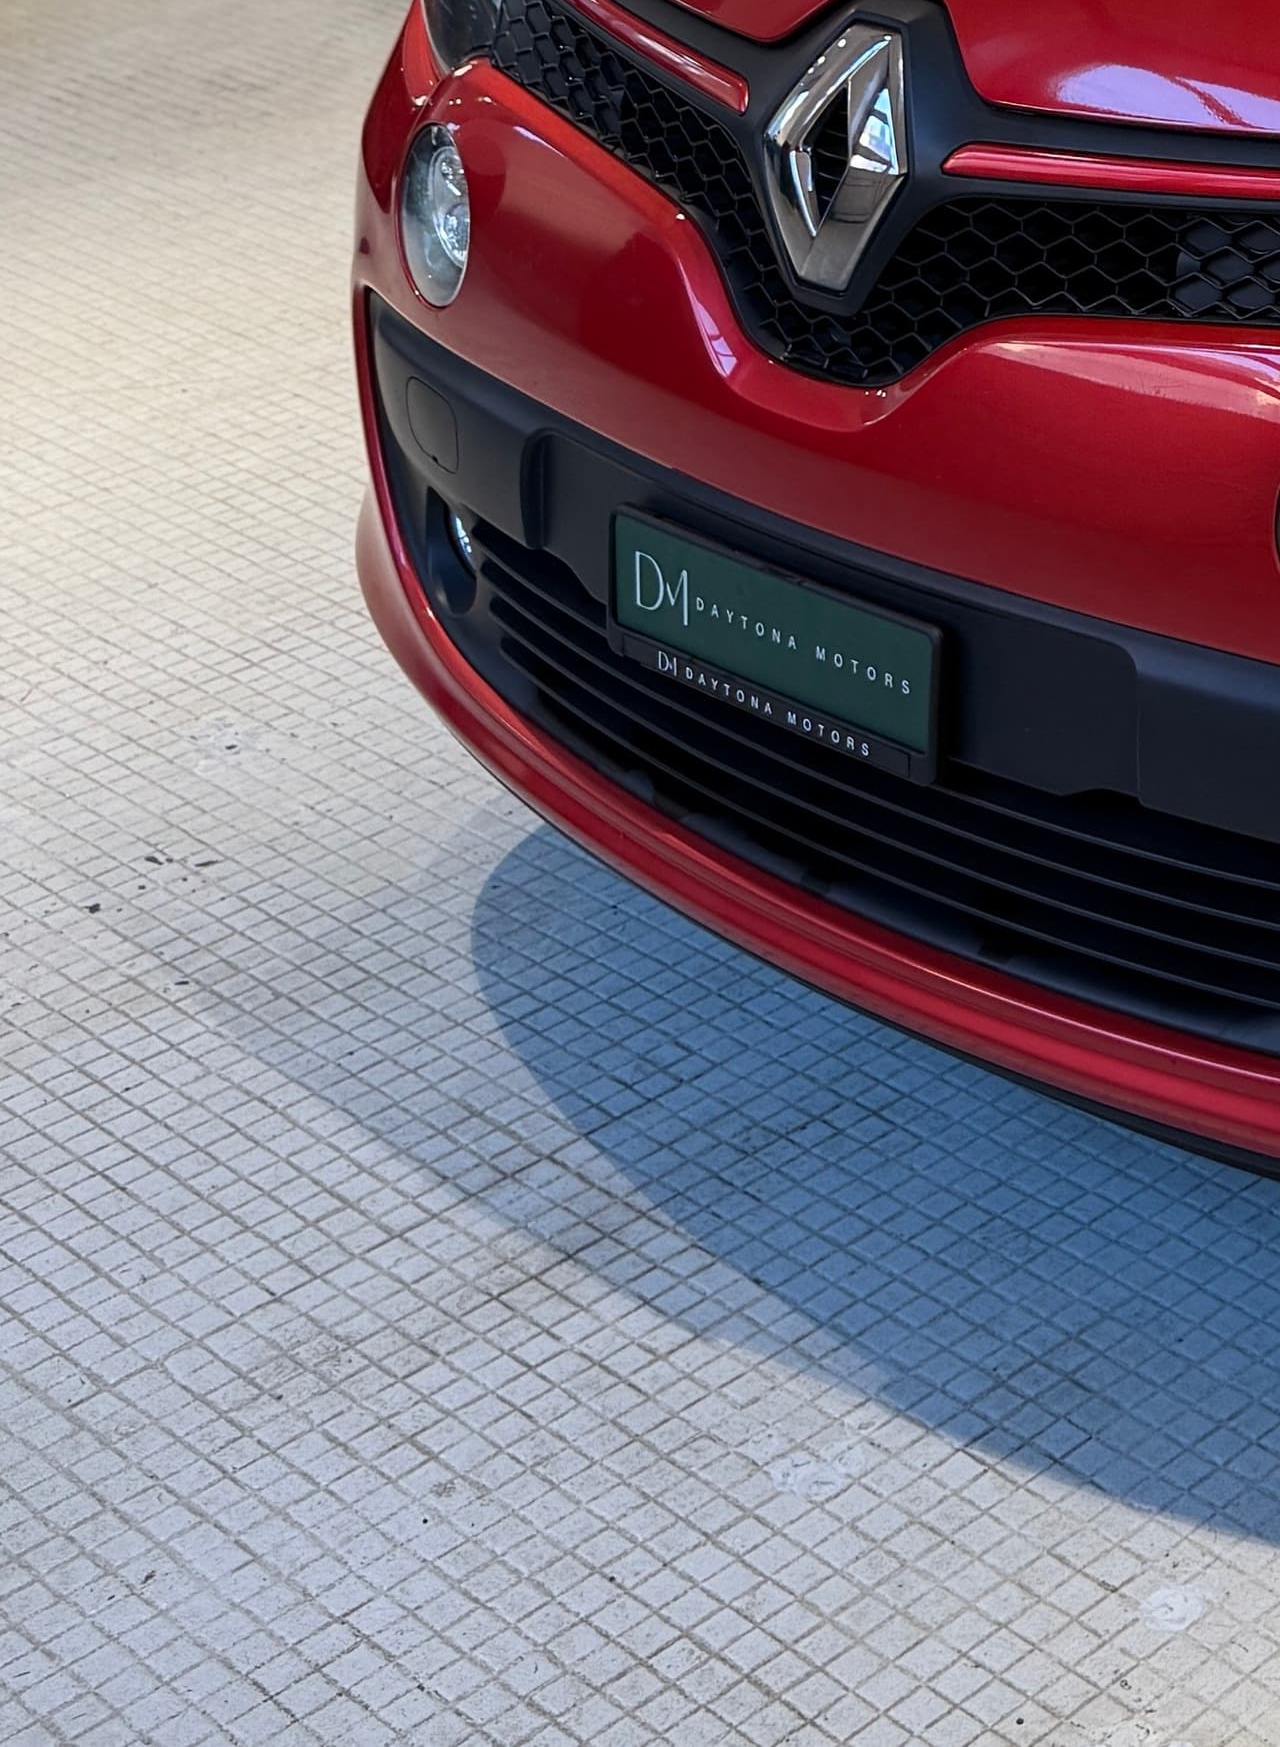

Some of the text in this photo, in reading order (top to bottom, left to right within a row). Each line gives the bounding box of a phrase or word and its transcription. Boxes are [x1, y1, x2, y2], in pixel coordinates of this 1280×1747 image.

[695, 596, 797, 650] DAYTONA
[815, 645, 911, 695] MOTORS
[685, 665, 773, 716] DAYTONA
[787, 711, 870, 757] MOTORS
